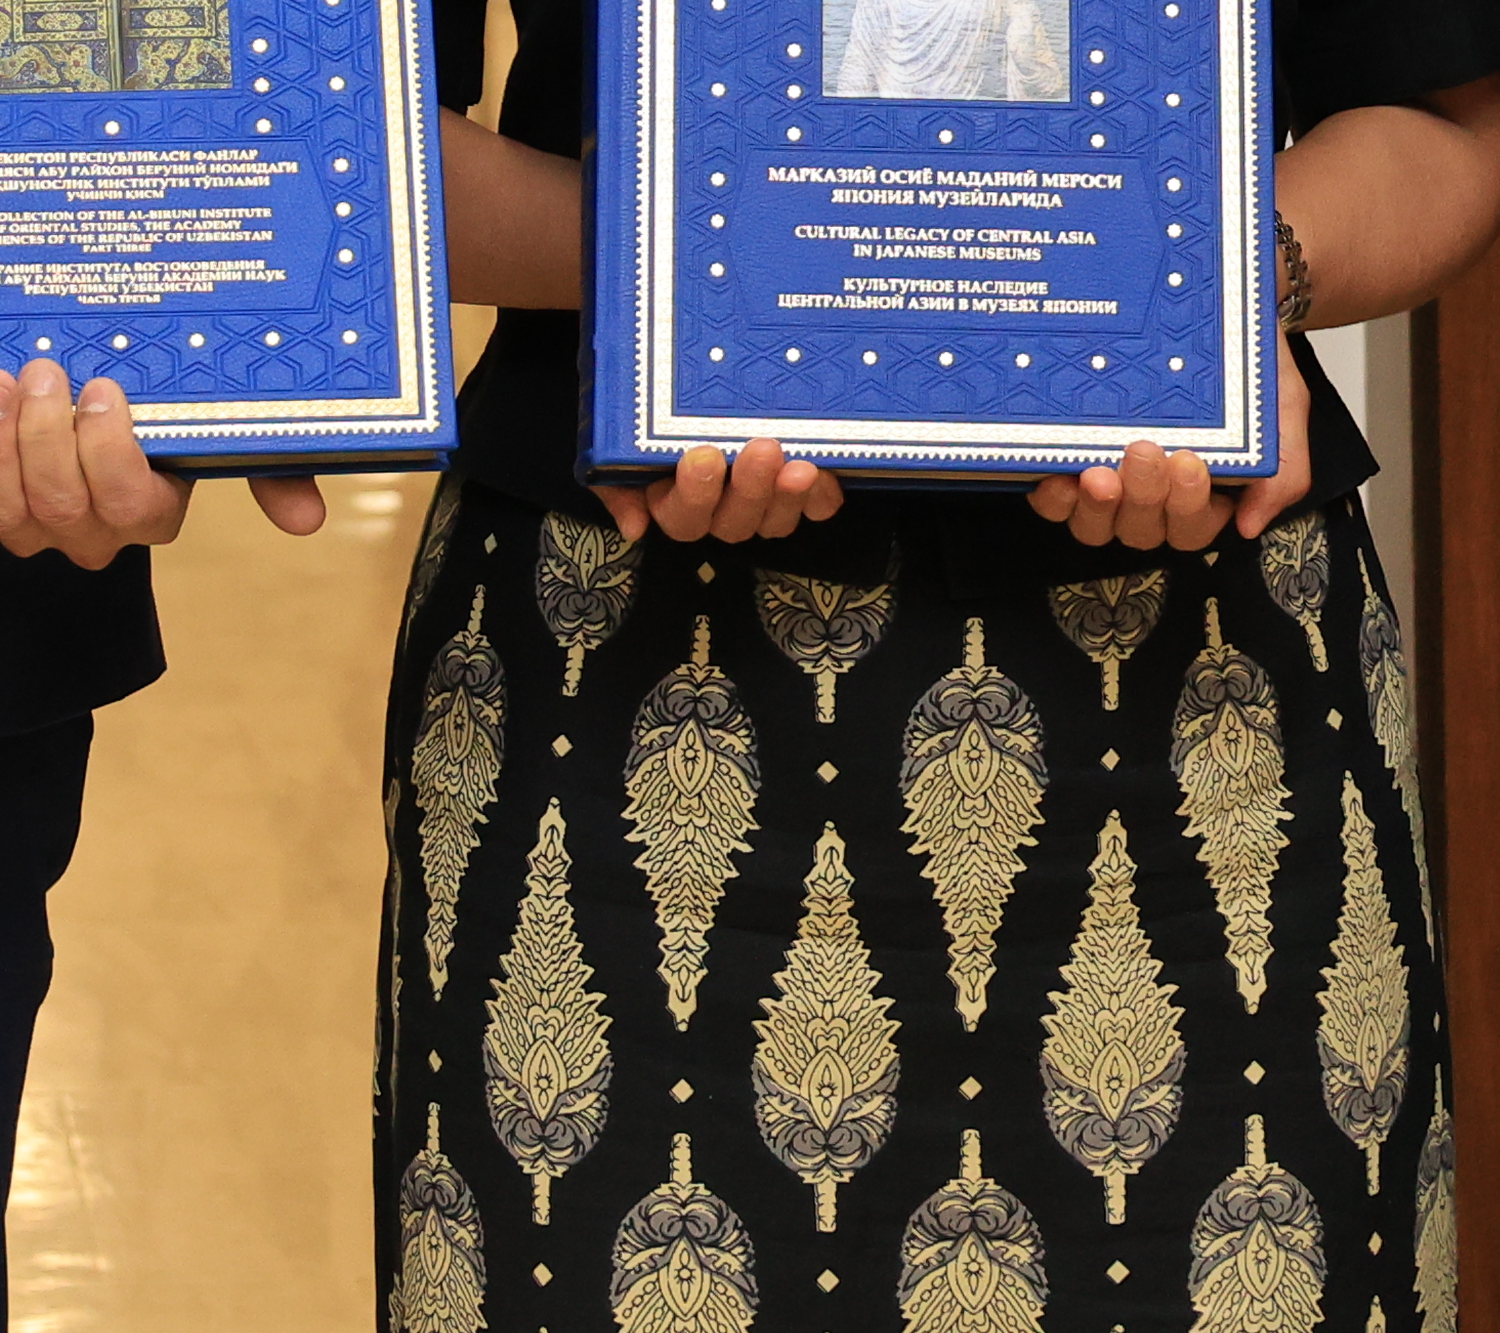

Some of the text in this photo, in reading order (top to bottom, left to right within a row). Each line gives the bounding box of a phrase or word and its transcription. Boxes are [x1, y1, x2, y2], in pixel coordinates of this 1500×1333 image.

[768, 165, 1121, 189] МАРКАЗИЙ ОСИЁ МАДАНИЙ МЕРОСИ
[831, 187, 1062, 209] ЯПОНИЯ МУЗЕЙЛАРИДА
[76, 210, 95, 220] OF
[97, 210, 125, 220] THE
[143, 220, 170, 230] THE
[794, 224, 1095, 245] CULTURAL LEGACY OF CENTRAL ASIA
[47, 234, 65, 244] OF
[68, 233, 95, 243] THE
[164, 232, 184, 242] OF
[853, 243, 1041, 260] IN JAPANESE MUSEUMS
[843, 277, 1047, 296] КУЛЬТУРНОЕ НАСЛЕДИЕ
[778, 291, 1117, 314] ЦЕНТРАЛЬНОЙ АЗИИ В МУЗЕЯХ ЯПОНИИ
